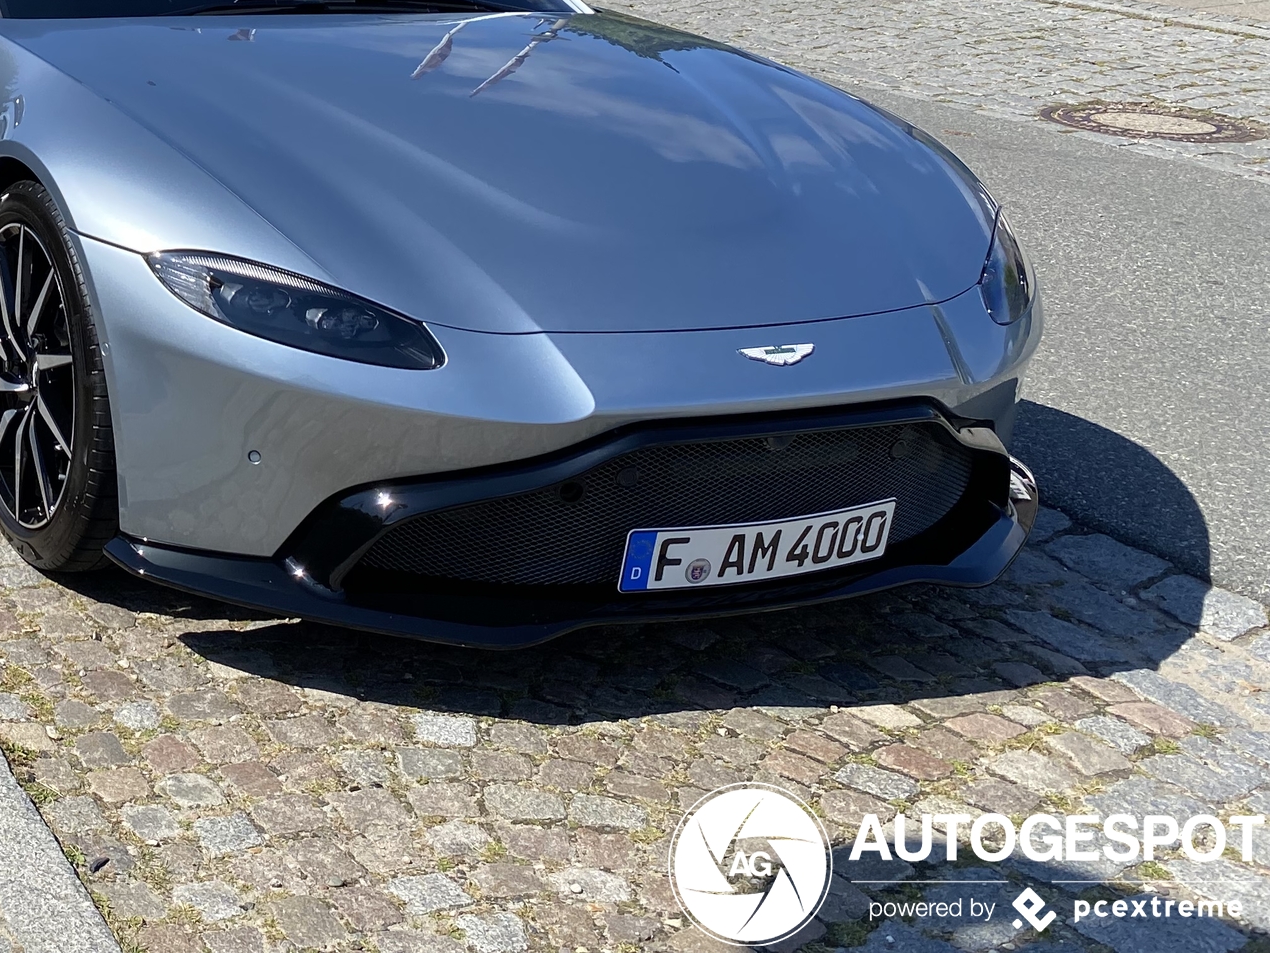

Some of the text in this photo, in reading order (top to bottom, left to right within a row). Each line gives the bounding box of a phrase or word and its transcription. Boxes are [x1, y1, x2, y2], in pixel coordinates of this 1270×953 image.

[654, 510, 887, 582] F AM 4000
[630, 566, 642, 580] D
